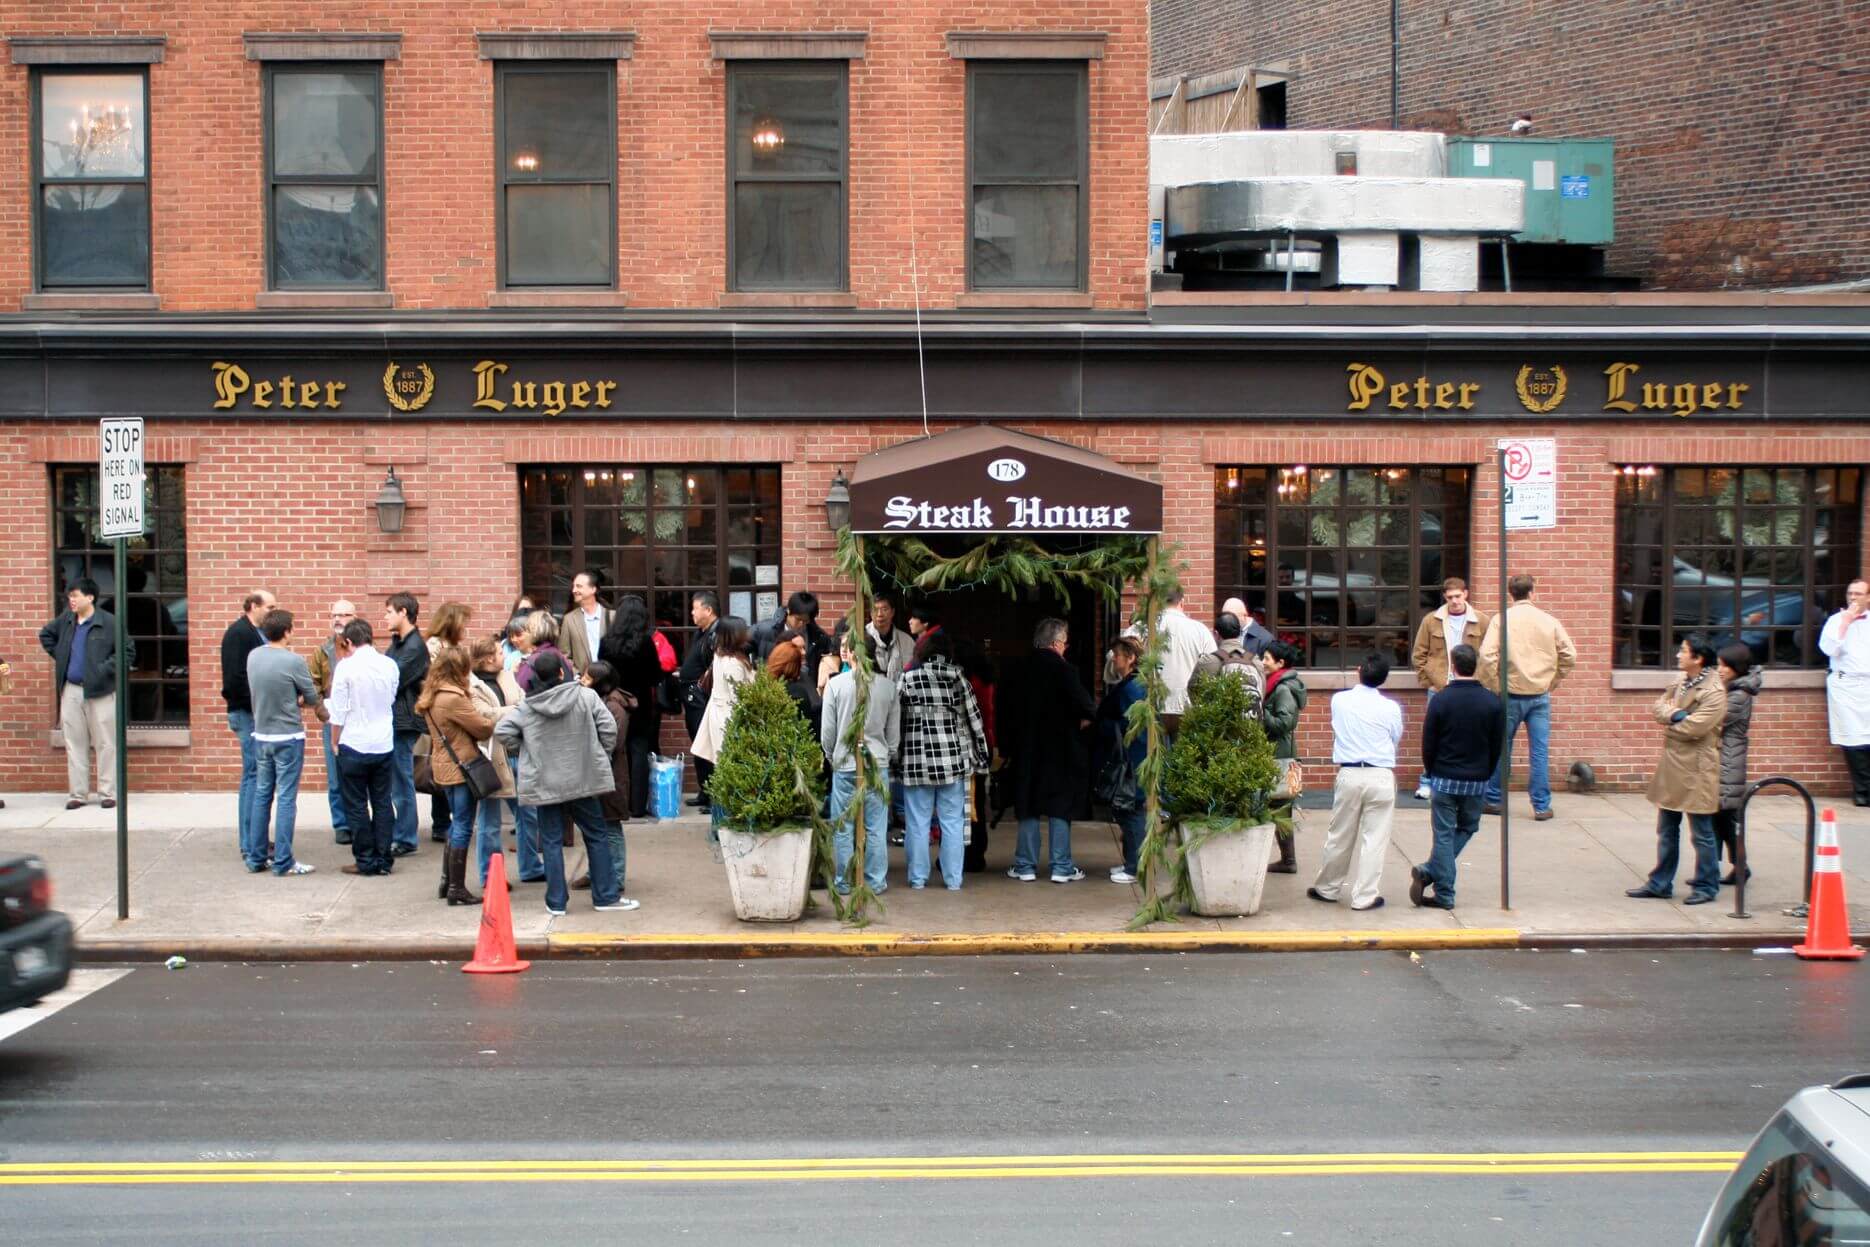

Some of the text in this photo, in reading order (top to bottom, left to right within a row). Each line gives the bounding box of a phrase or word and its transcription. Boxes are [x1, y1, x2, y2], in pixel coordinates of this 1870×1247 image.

[211, 360, 617, 416] Peter Luger
[396, 381, 423, 393] 1887
[1346, 362, 1749, 417] Peter Luger
[1528, 383, 1555, 394] 1887
[104, 428, 140, 454] STOP
[105, 459, 140, 477] HERE ON
[995, 463, 1019, 477] 178
[113, 483, 131, 500] RED
[105, 506, 139, 525] SIGNAL
[883, 496, 1131, 529] Steak House
